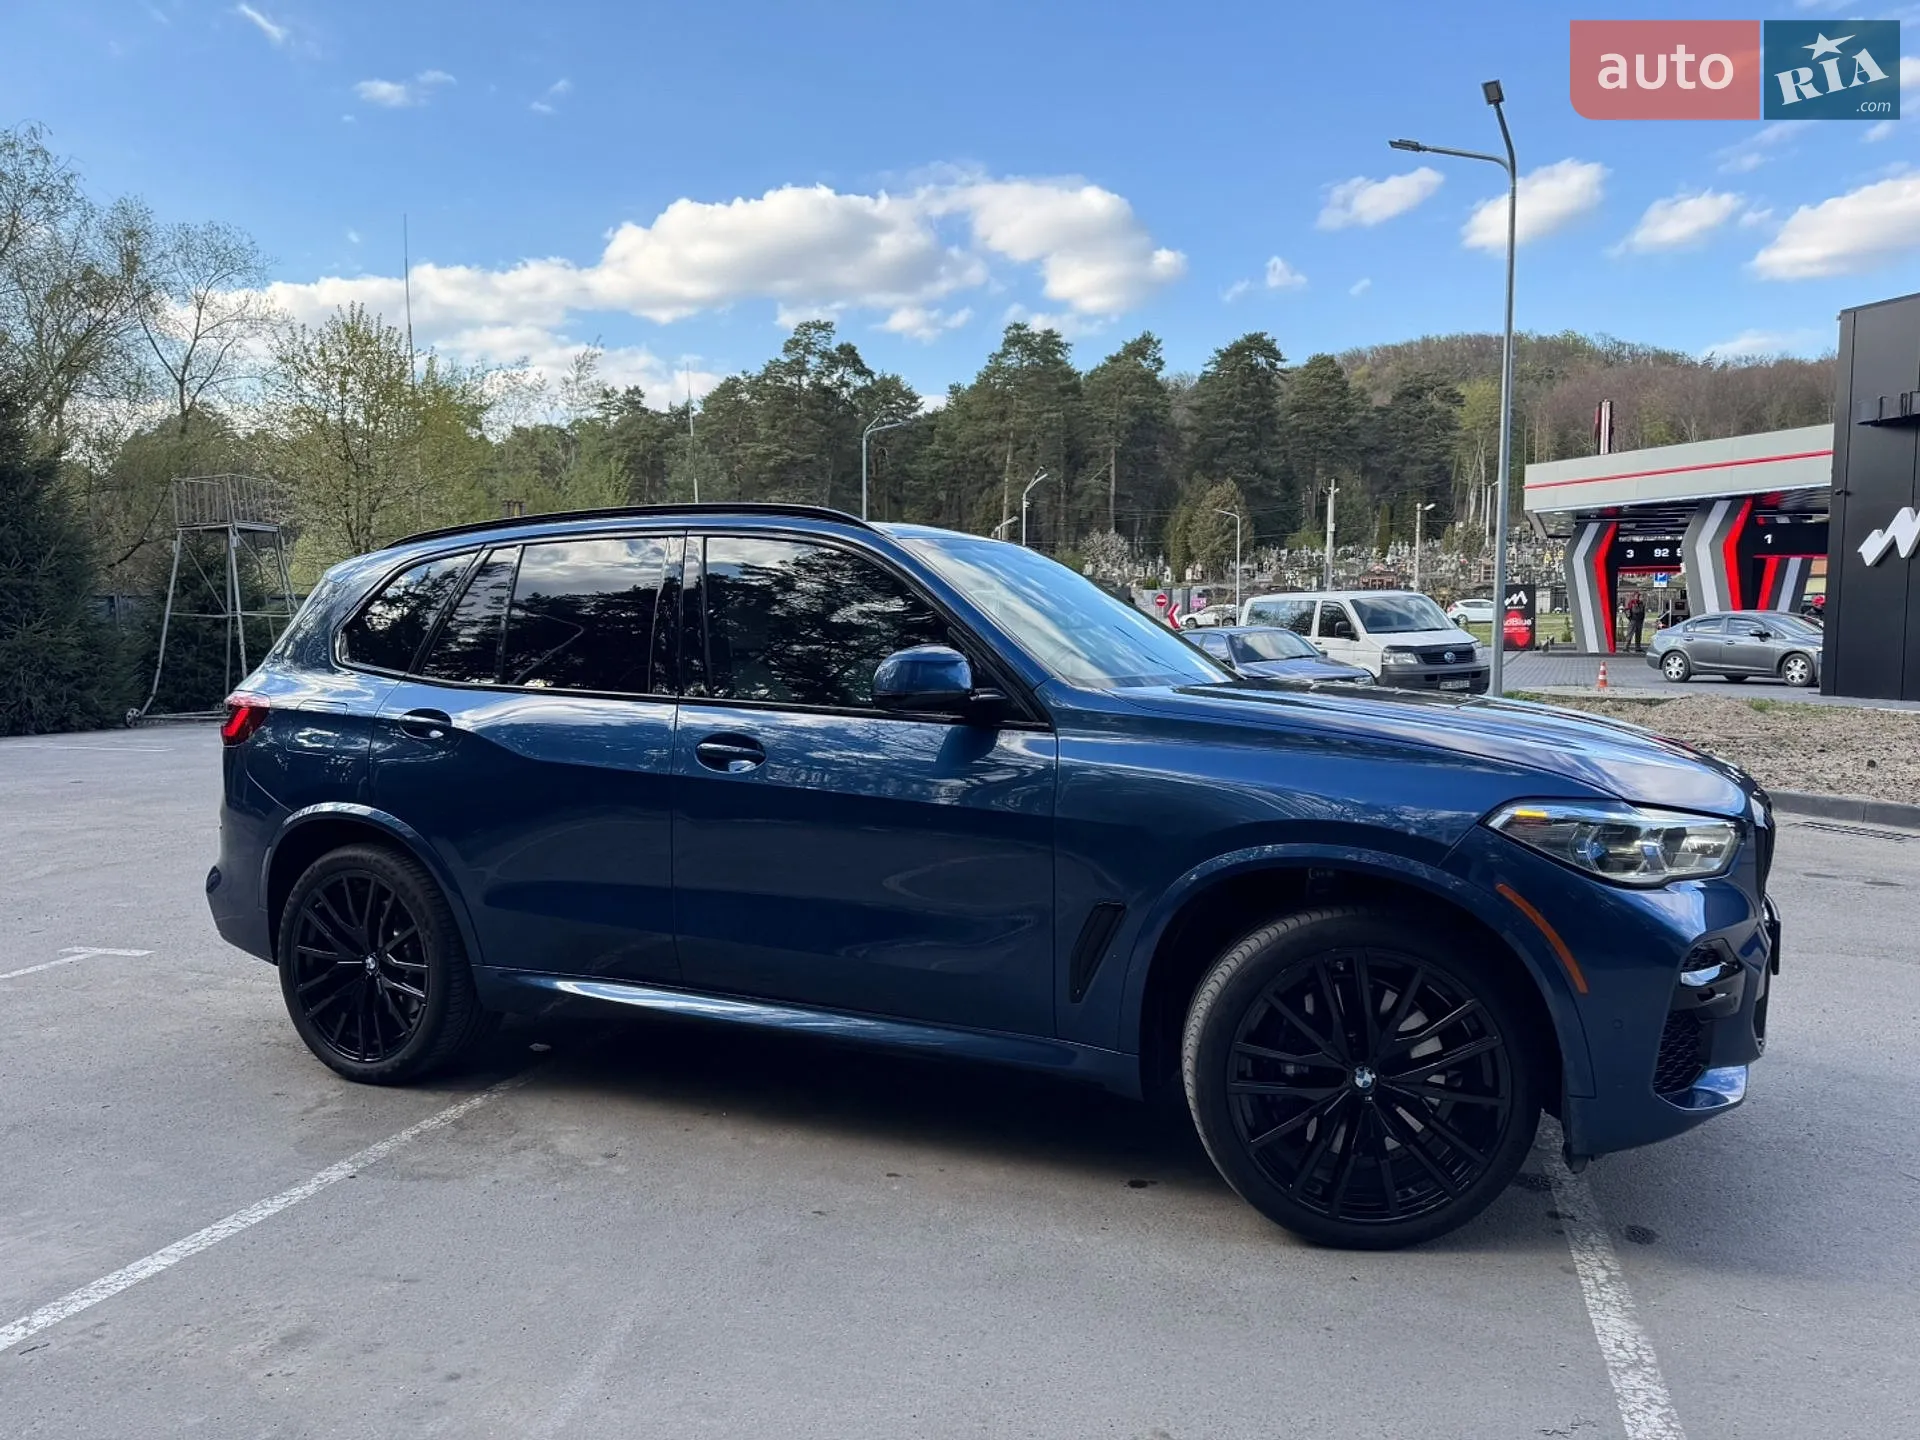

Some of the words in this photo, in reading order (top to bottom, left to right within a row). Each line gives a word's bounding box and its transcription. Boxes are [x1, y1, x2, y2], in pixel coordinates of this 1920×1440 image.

[1764, 533, 1772, 544] 1
[1626, 549, 1635, 558] 3
[1654, 548, 1670, 557] 92
